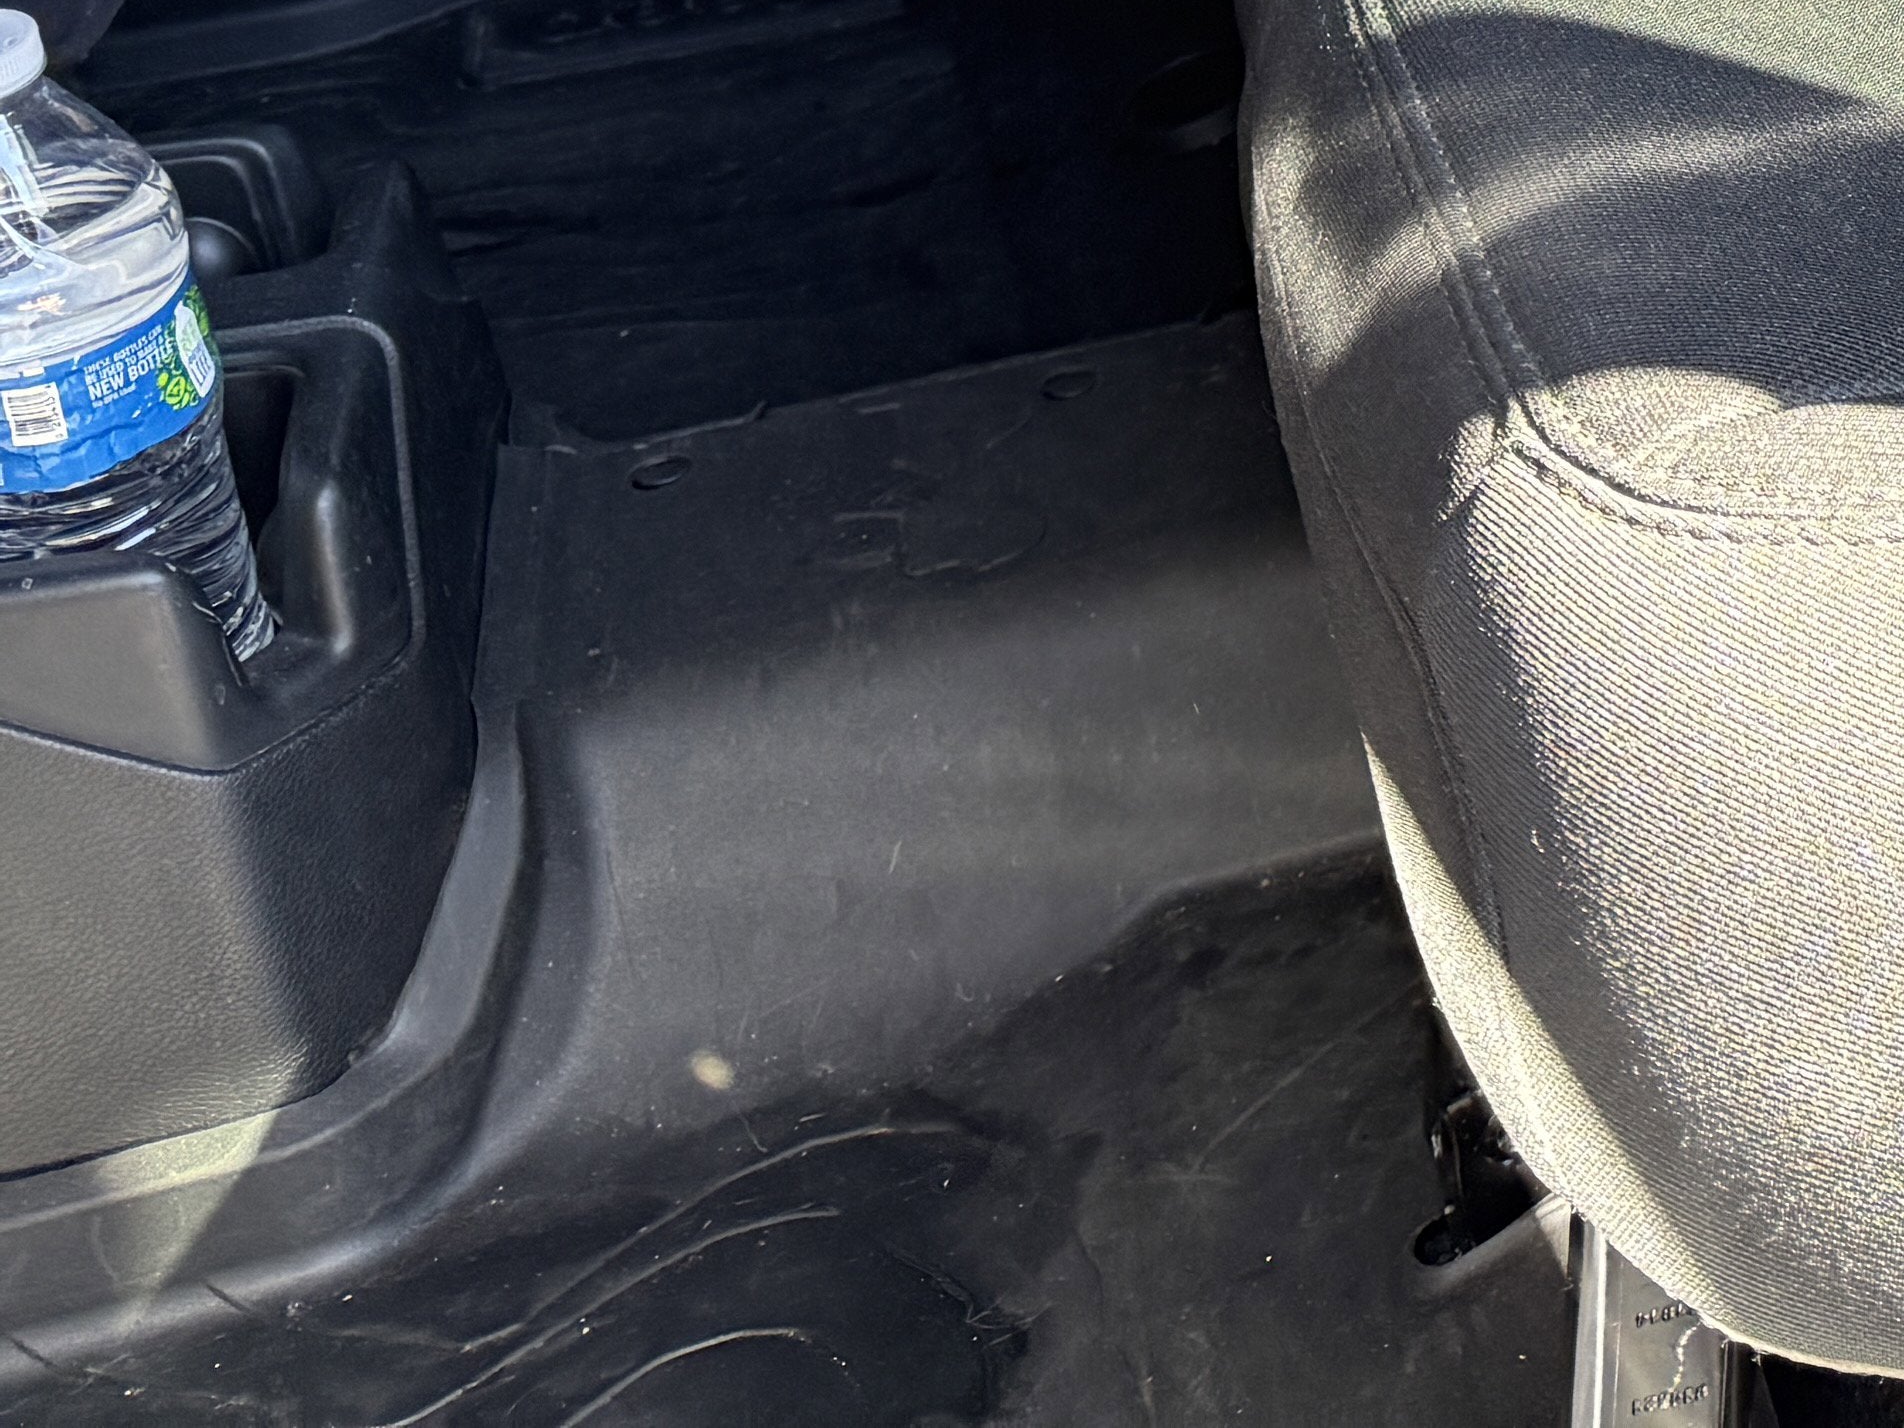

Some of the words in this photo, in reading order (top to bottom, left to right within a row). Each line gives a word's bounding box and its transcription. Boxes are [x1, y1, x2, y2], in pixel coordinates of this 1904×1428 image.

[88, 371, 125, 400] NEW
[128, 337, 176, 382] BOTTLE
[125, 355, 137, 366] TO
